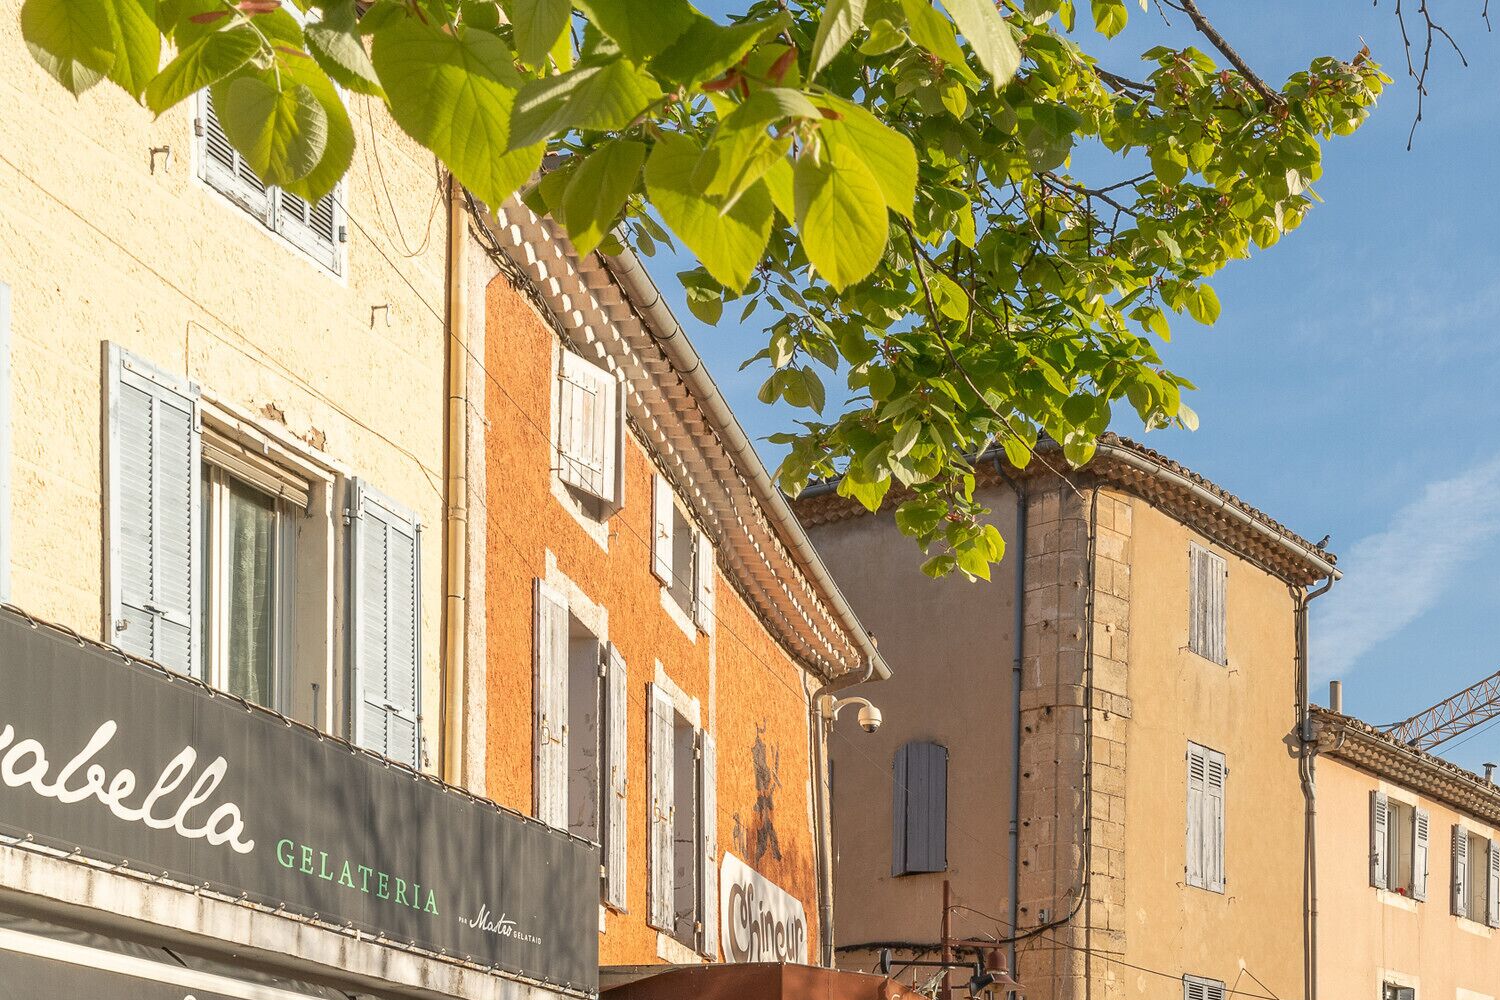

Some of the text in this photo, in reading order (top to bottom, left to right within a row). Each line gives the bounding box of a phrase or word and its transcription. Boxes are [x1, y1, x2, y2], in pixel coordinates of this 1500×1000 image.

[0, 719, 440, 917] abella GELATERIA
[458, 916, 468, 925] PAR
[728, 881, 803, 962] Chineur
